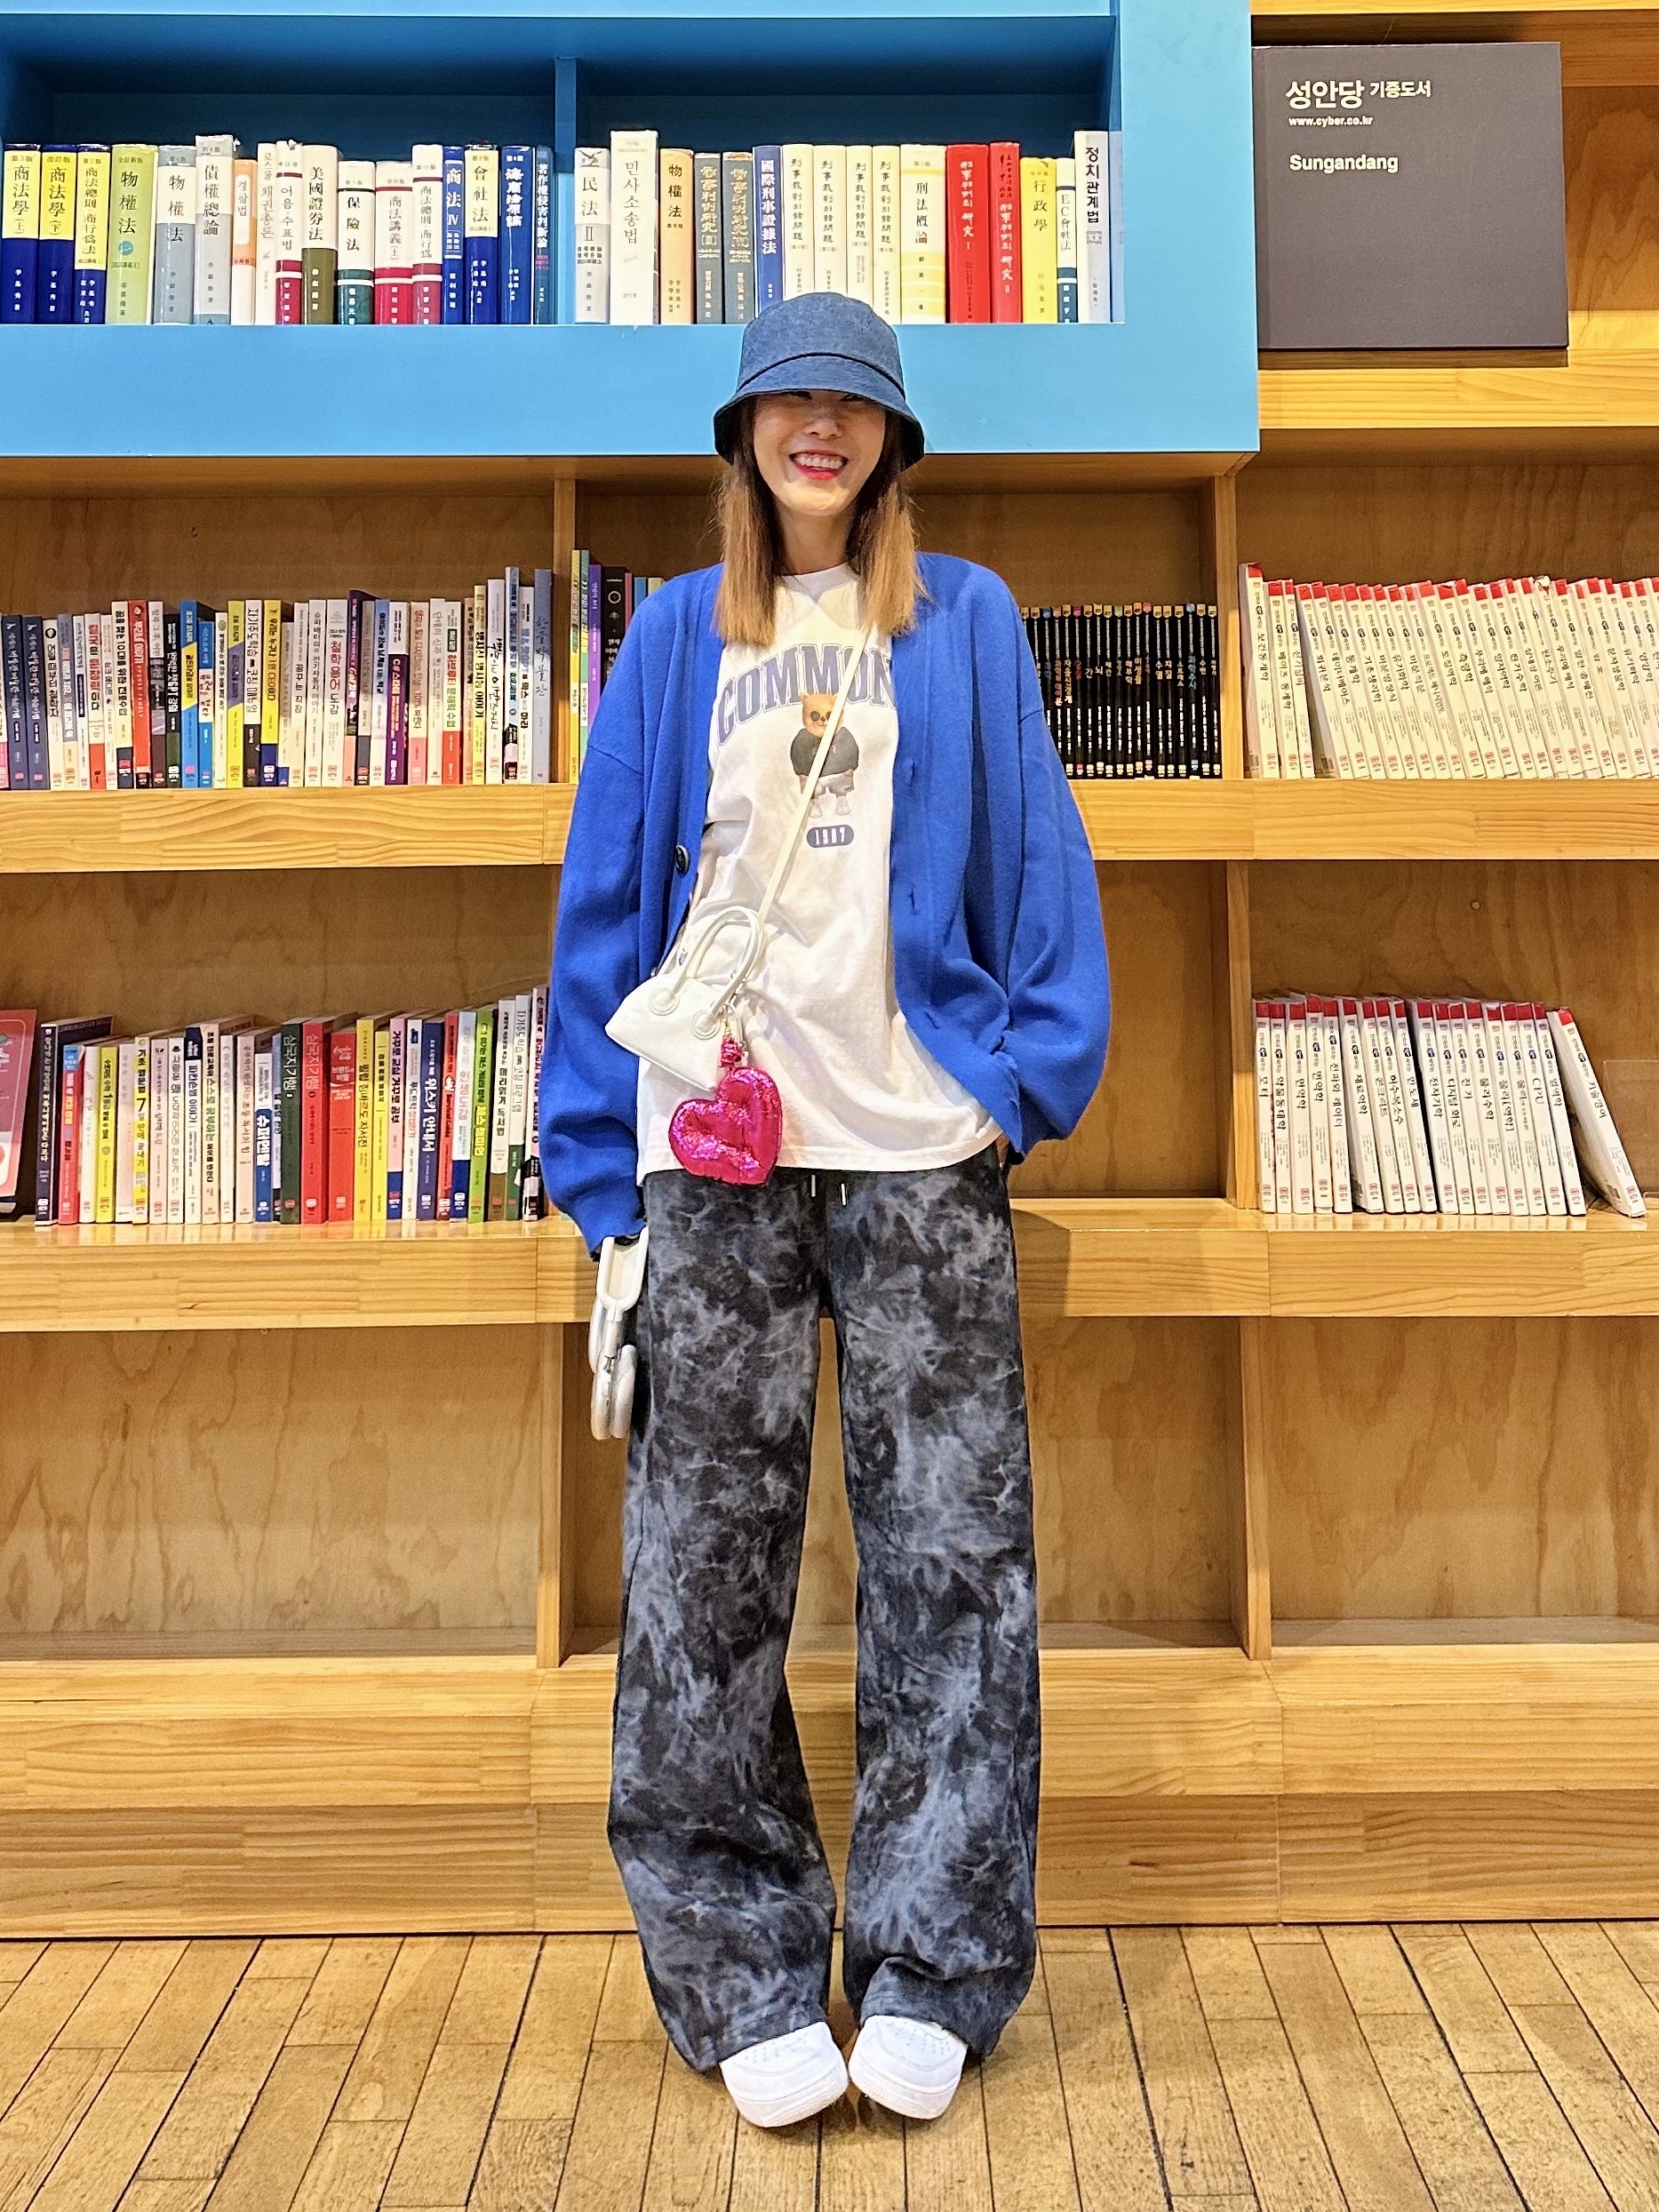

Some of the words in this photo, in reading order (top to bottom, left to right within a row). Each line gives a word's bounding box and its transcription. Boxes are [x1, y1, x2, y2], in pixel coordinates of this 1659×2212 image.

[1286, 80, 1365, 109] 성안당
[1369, 80, 1431, 98] 기증도서
[1288, 116, 1374, 127] www.cyber.co.kr
[1289, 154, 1399, 173] Sungandang
[473, 165, 489, 222] 會社法
[668, 164, 682, 218] 物權法
[1086, 147, 1099, 223] 정치관계법
[117, 171, 138, 235] 物權法
[168, 175, 187, 242] 物權法
[623, 160, 640, 244] 민사소송법
[331, 641, 341, 665] 철학
[330, 667, 340, 691] 용어
[330, 694, 339, 715] 도감
[716, 643, 897, 746] COMMON
[392, 1058, 401, 1075] 교실
[391, 1077, 401, 1104] 거꾸로
[423, 1078, 438, 1113] 위스키
[1532, 1078, 1544, 1105] CPU
[188, 1099, 197, 1123] 이야기
[256, 1114, 270, 1166] 슈퍼멘탈
[358, 1121, 369, 1147] 자서전
[423, 1116, 435, 1152] 안내서
